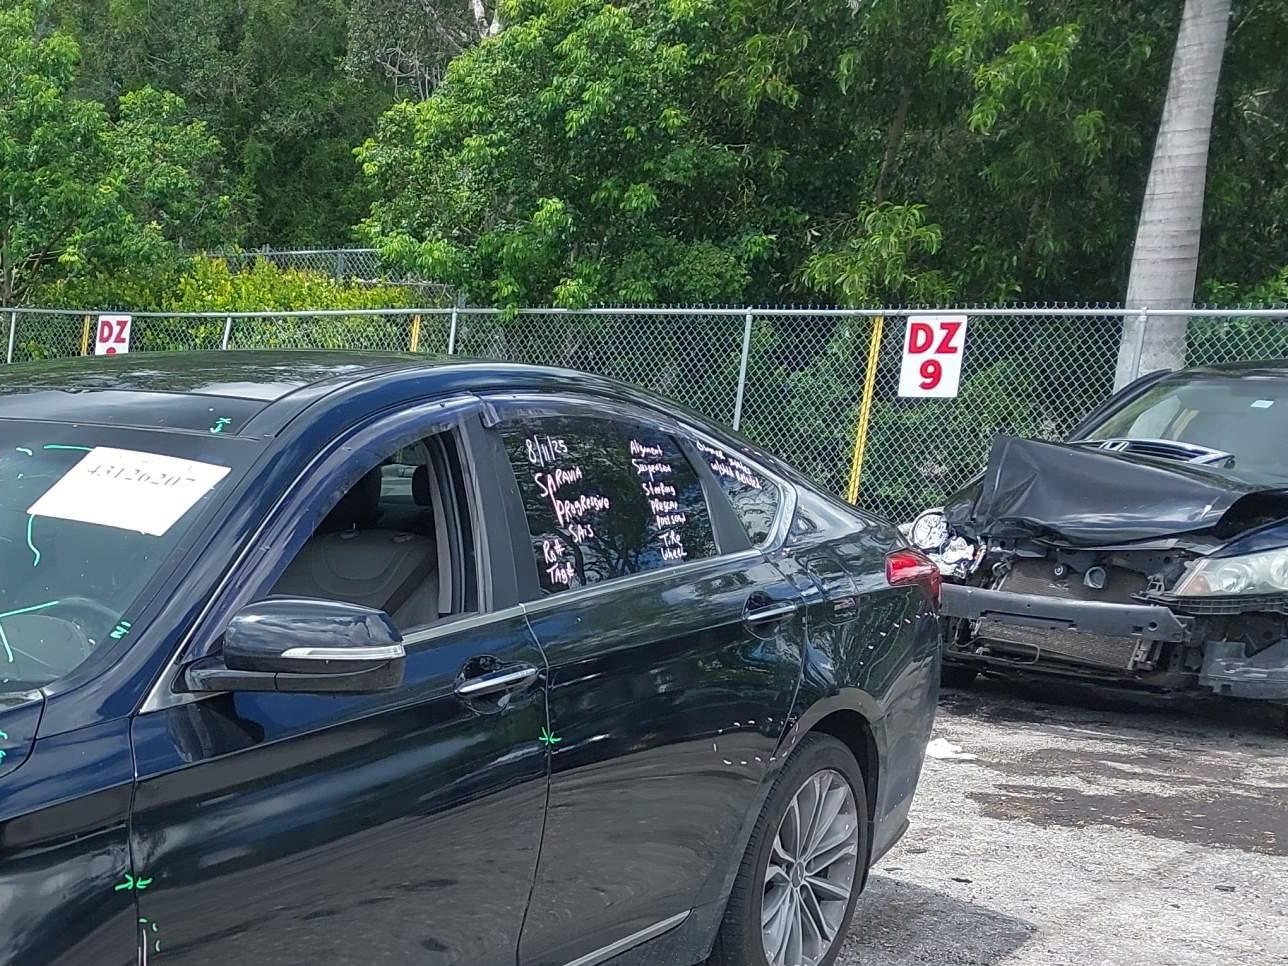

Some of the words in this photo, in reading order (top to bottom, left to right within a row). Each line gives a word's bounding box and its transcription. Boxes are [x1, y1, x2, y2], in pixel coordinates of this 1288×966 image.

[99, 320, 129, 343] DZ
[908, 322, 962, 354] DZ
[919, 359, 942, 390] 9
[526, 434, 568, 467] 8/11/25
